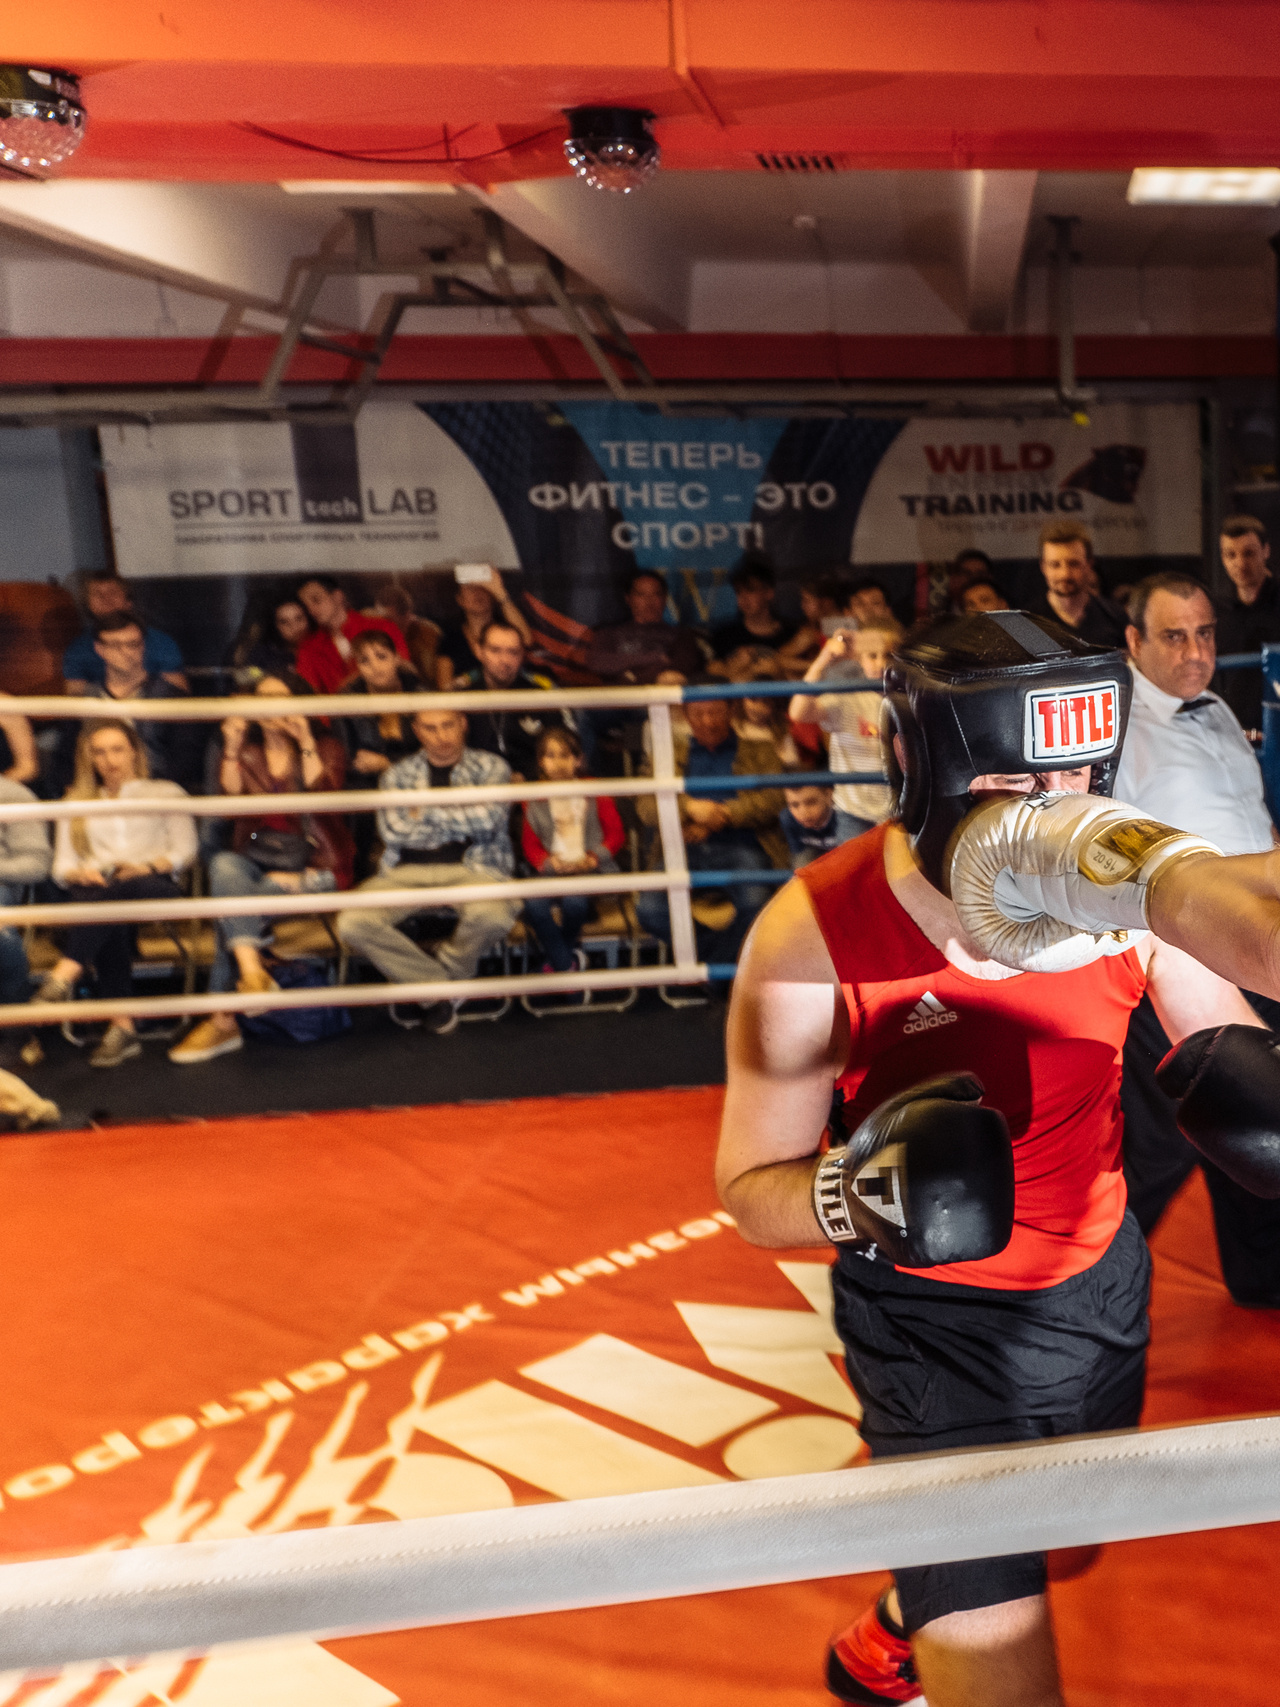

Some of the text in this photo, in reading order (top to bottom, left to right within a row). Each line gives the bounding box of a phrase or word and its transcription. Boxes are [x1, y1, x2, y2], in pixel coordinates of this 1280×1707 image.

[599, 440, 763, 470] ТЕПЕРЬ
[921, 442, 1056, 474] WILD
[168, 488, 293, 520] SPORT
[366, 487, 438, 516] LAB
[527, 480, 711, 511] ФИТНЕС
[753, 480, 838, 511] ЭТО
[900, 490, 1084, 517] TRAINING
[611, 520, 764, 550] СПОРТ!
[1037, 691, 1114, 748] TITLE
[902, 1010, 958, 1035] adidas
